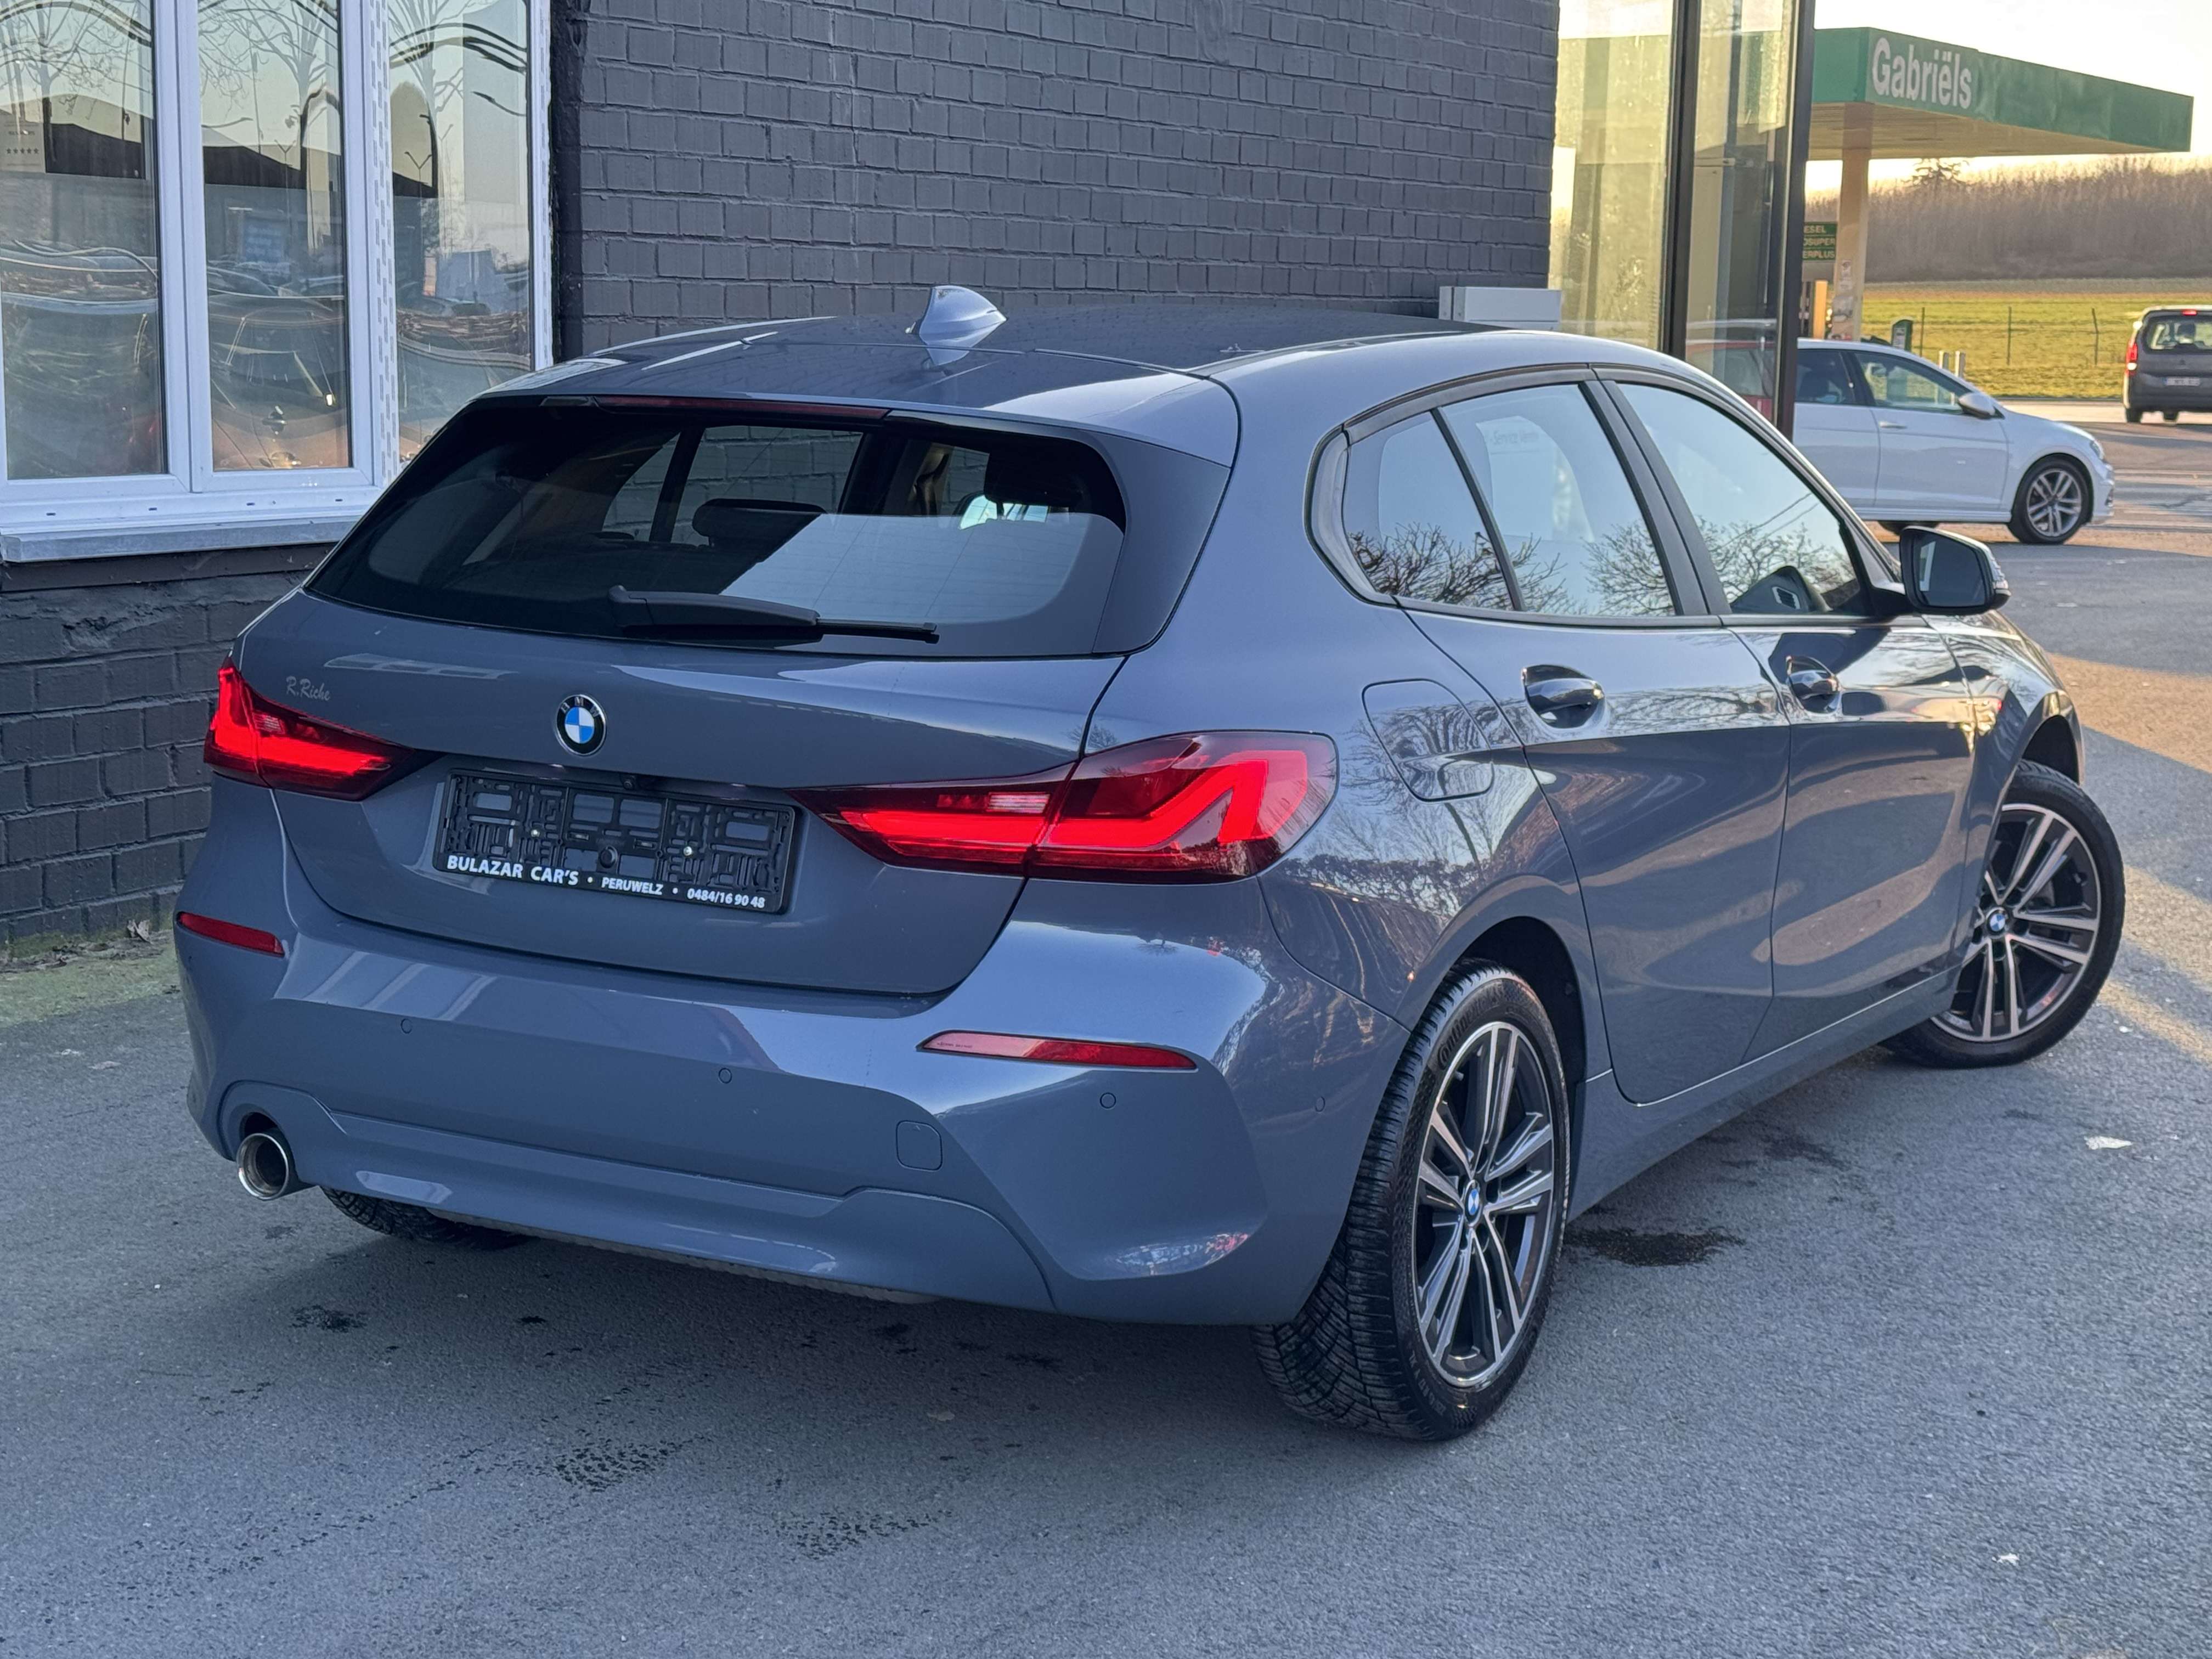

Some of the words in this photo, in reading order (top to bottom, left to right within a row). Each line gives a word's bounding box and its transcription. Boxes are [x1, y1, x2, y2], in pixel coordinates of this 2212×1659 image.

[1872, 37, 1972, 109] Gabriëls
[1803, 225, 1826, 233] ESEL
[1803, 238, 1835, 246] OSUPER
[1803, 250, 1835, 258] ERPLUS
[561, 696, 600, 718] BMW
[447, 855, 523, 878] BULAZAR
[531, 866, 579, 885] CAR'S
[601, 877, 663, 895] PERUWELZ
[687, 888, 733, 905] 0484/16
[734, 894, 749, 906] 90
[750, 896, 765, 909] 48
